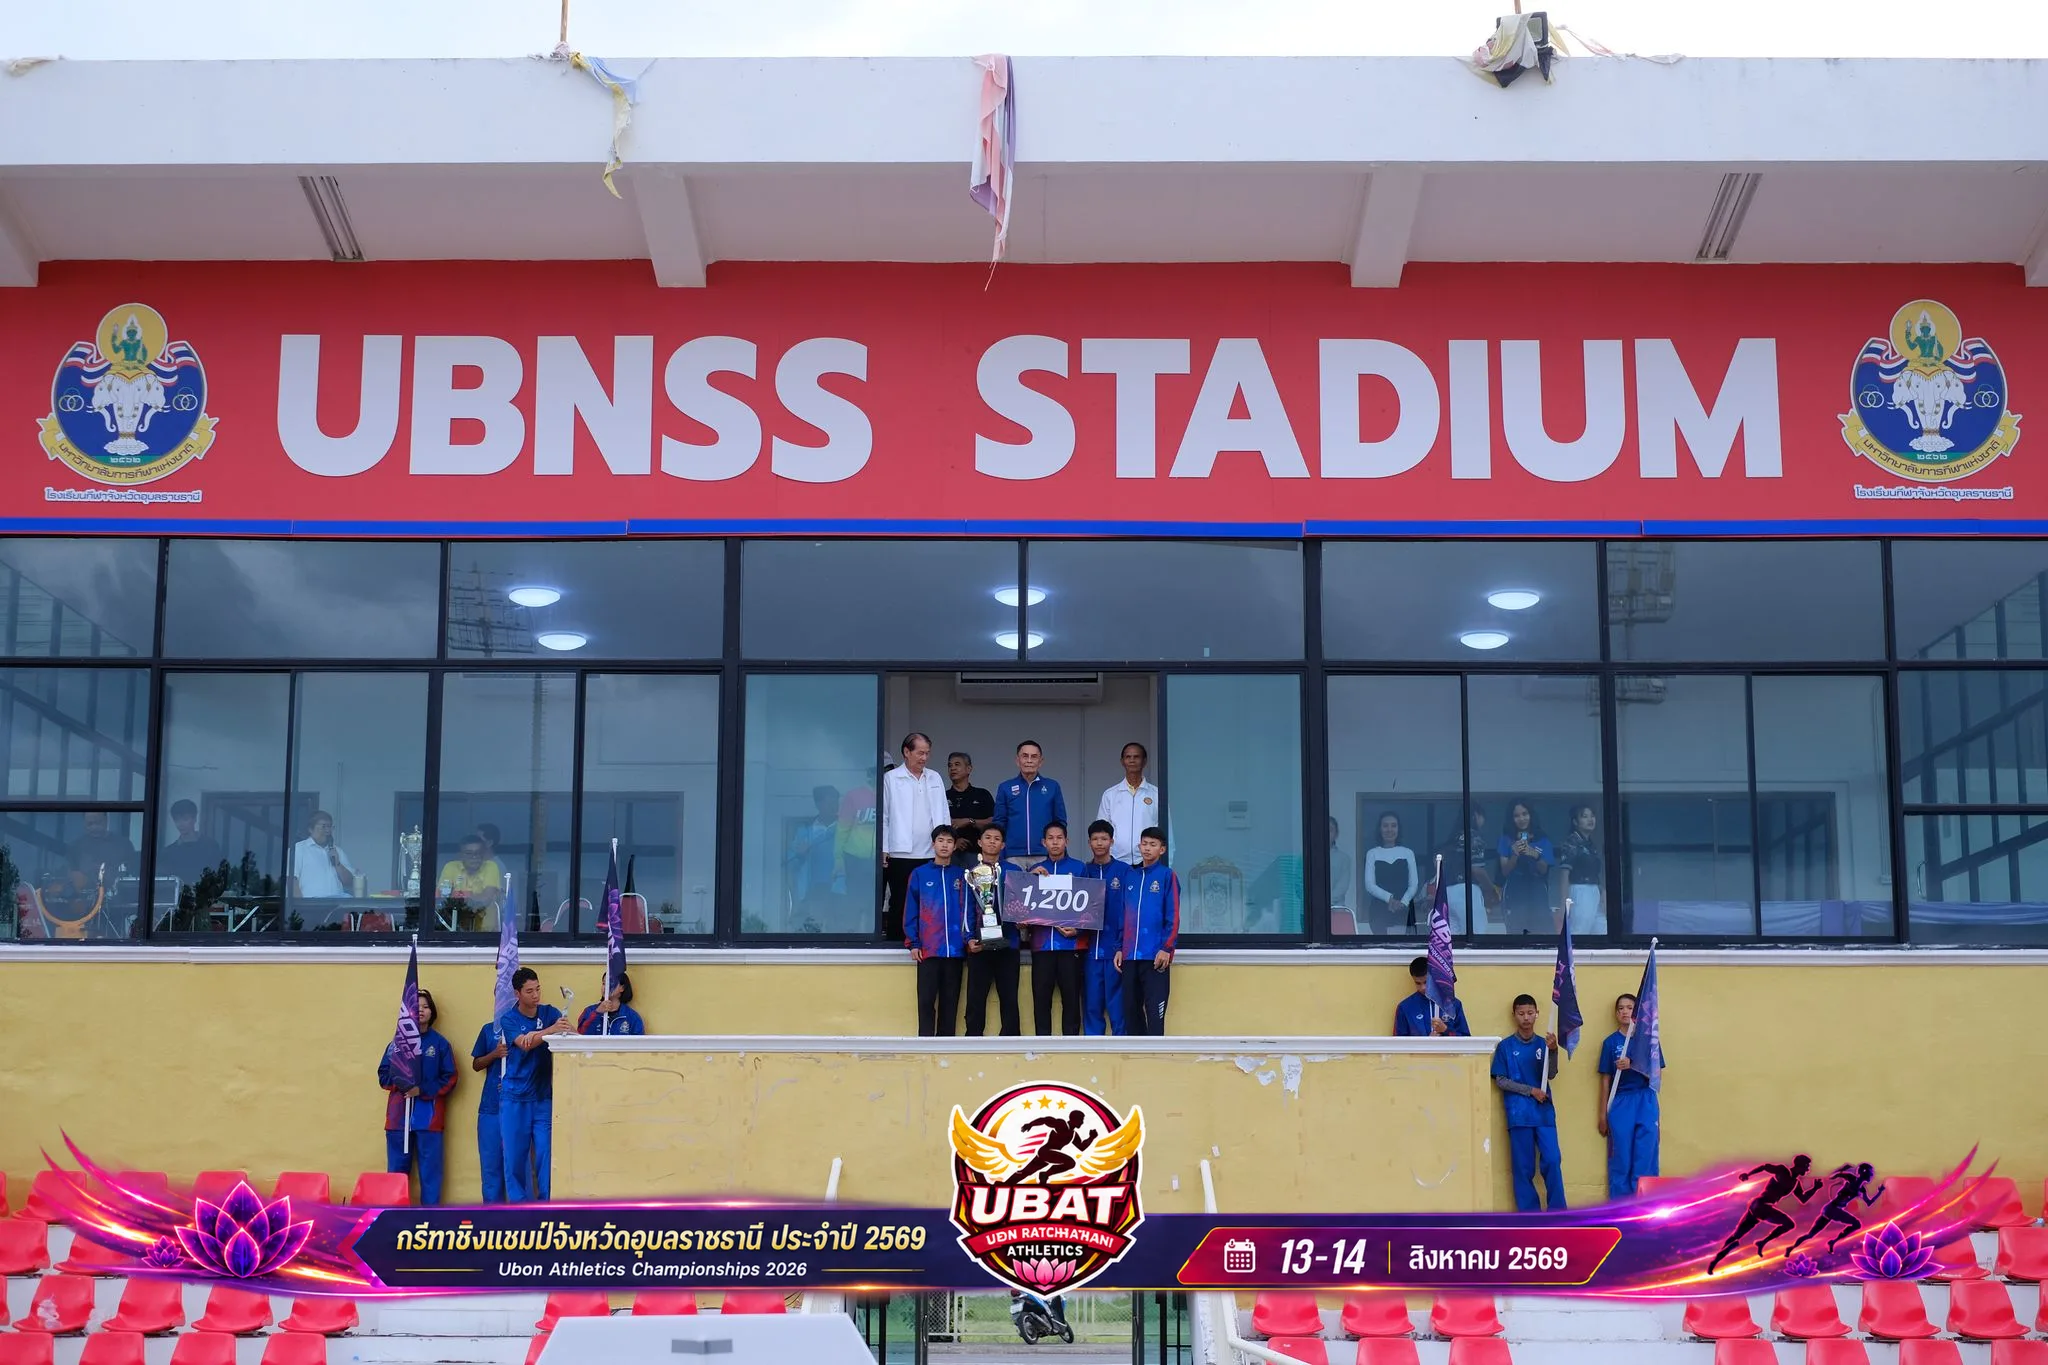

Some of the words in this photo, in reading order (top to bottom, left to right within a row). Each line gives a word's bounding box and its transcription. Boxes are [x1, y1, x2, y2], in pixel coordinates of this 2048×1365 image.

[278, 334, 873, 483] UBNSS
[974, 334, 1783, 483] STADIUM
[1022, 885, 1089, 912] 1,200
